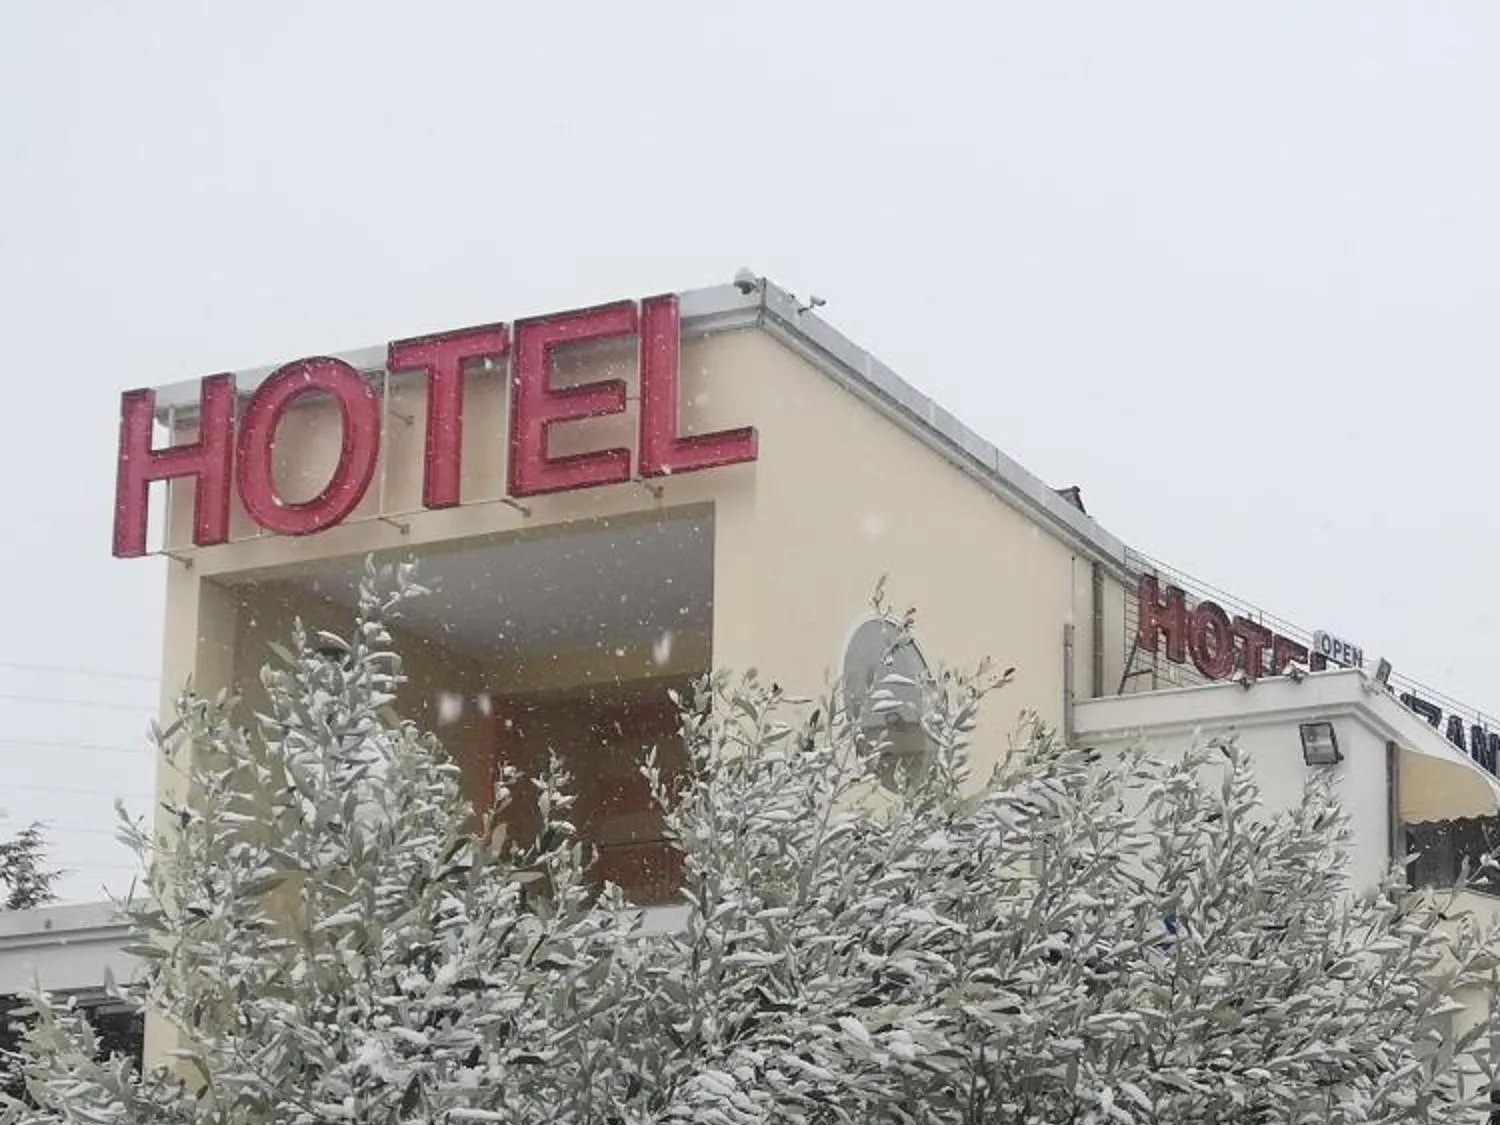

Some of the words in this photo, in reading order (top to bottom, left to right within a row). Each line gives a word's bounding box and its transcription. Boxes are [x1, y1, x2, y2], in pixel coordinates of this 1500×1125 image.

[112, 292, 758, 559] HOTEL
[1138, 572, 1327, 680] HOT
[1320, 632, 1363, 668] OPEN
